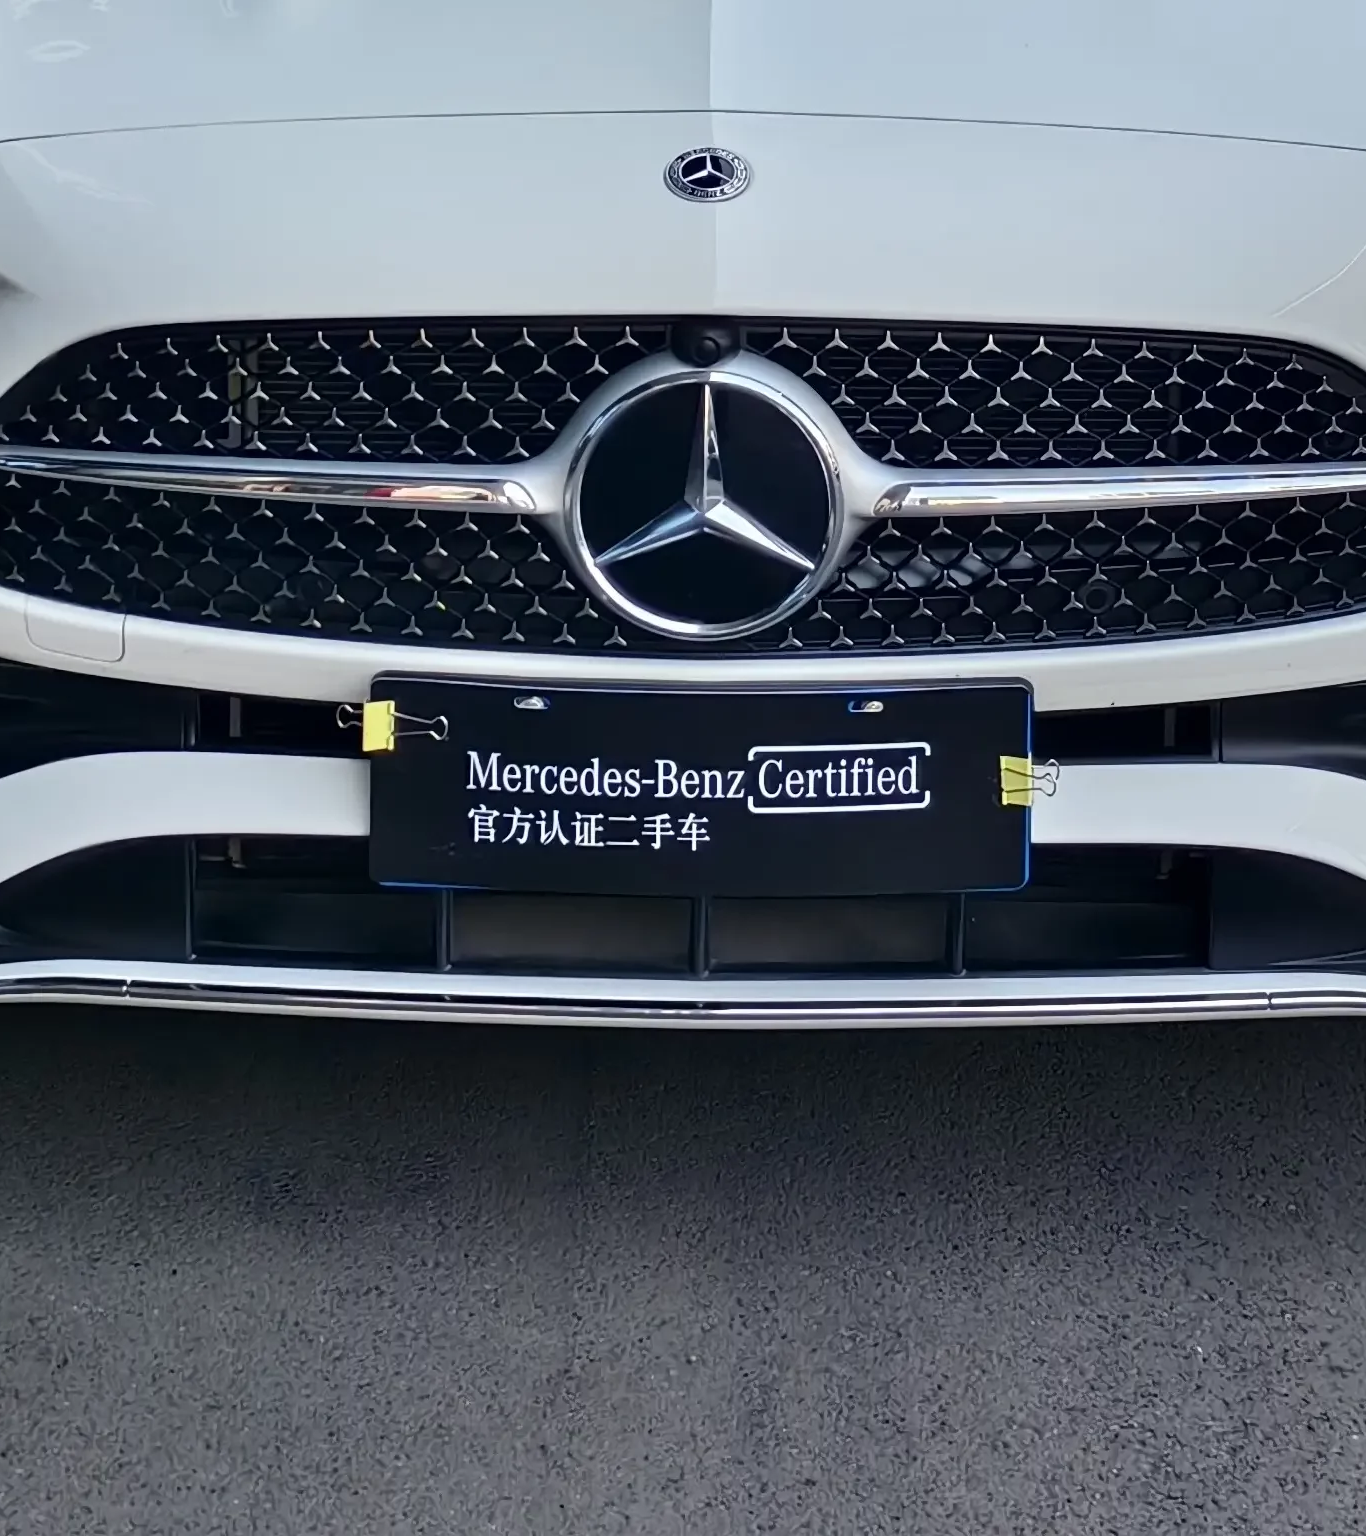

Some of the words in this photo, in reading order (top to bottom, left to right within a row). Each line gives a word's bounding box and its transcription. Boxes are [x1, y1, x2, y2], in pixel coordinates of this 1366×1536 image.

[466, 750, 745, 799] Mercedes-Benz
[757, 754, 920, 799] Certified
[467, 804, 711, 852] 官方认证二手车
